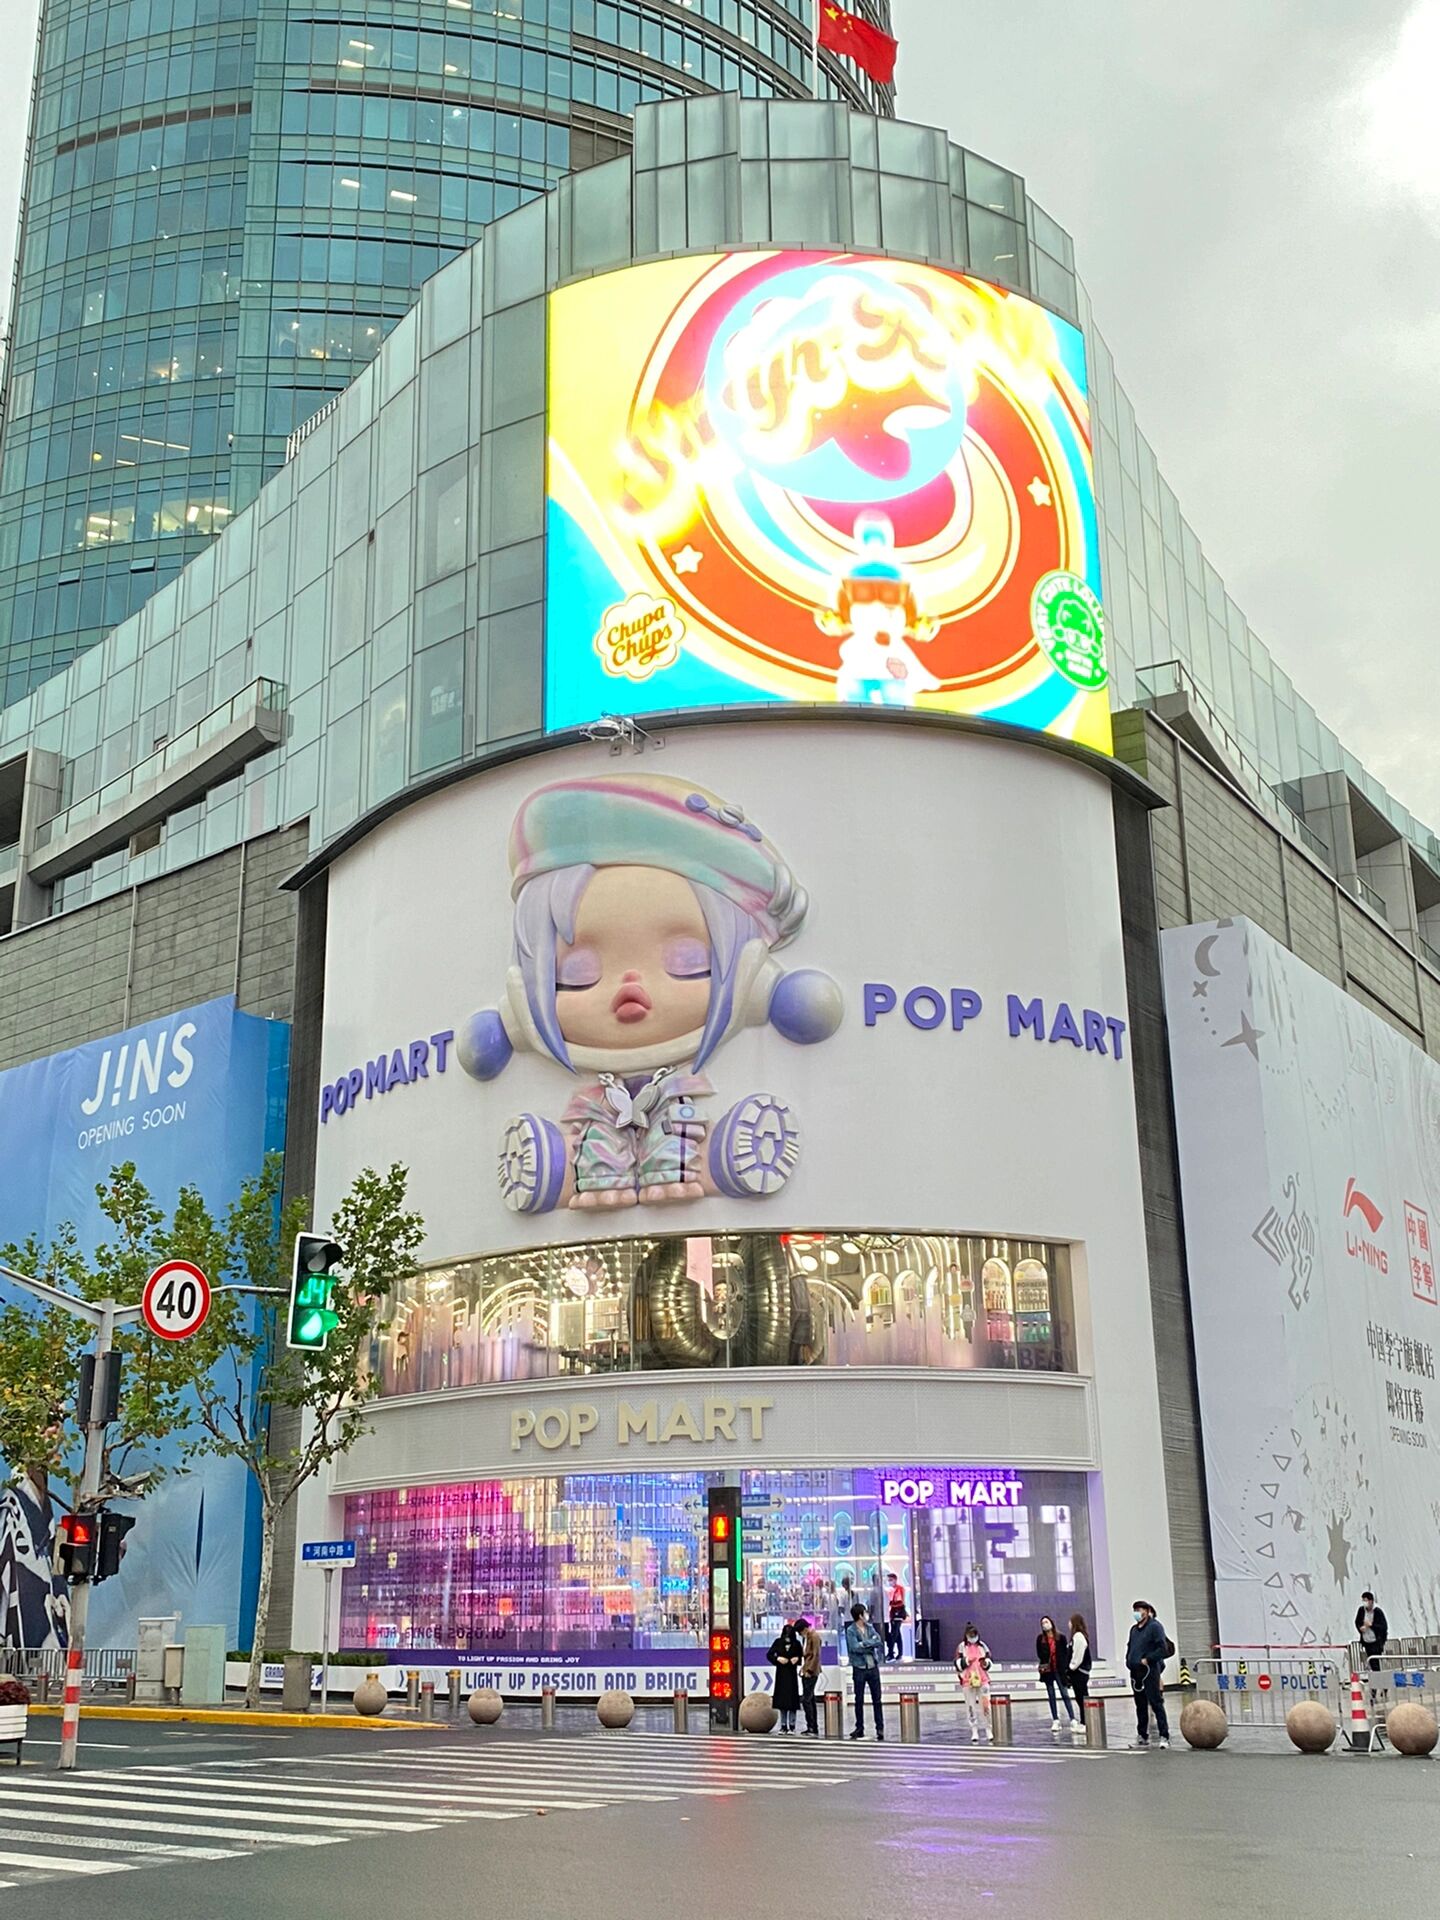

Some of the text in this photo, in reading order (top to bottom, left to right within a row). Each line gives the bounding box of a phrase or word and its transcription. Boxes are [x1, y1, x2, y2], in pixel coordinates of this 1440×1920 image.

[607, 605, 666, 646] Chupa
[612, 623, 673, 667] Chups
[864, 983, 1126, 1060] POP MART
[321, 1030, 454, 1124] POP MART
[78, 1101, 187, 1150] OPENING SOON
[156, 1280, 197, 1319] 40
[1366, 1320, 1435, 1380] 中国李宁旗舰店
[511, 1397, 773, 1450] POP MART
[1385, 1379, 1424, 1425] 即将开幕
[883, 1479, 1023, 1506] POP MART
[466, 1672, 502, 1689] LIGHT
[509, 1672, 525, 1690] UP
[532, 1672, 596, 1690] PASSION
[604, 1672, 636, 1691] AND
[645, 1672, 697, 1691] BRING
[1217, 1675, 1247, 1690] 警察
[1281, 1674, 1327, 1690] POLICE
